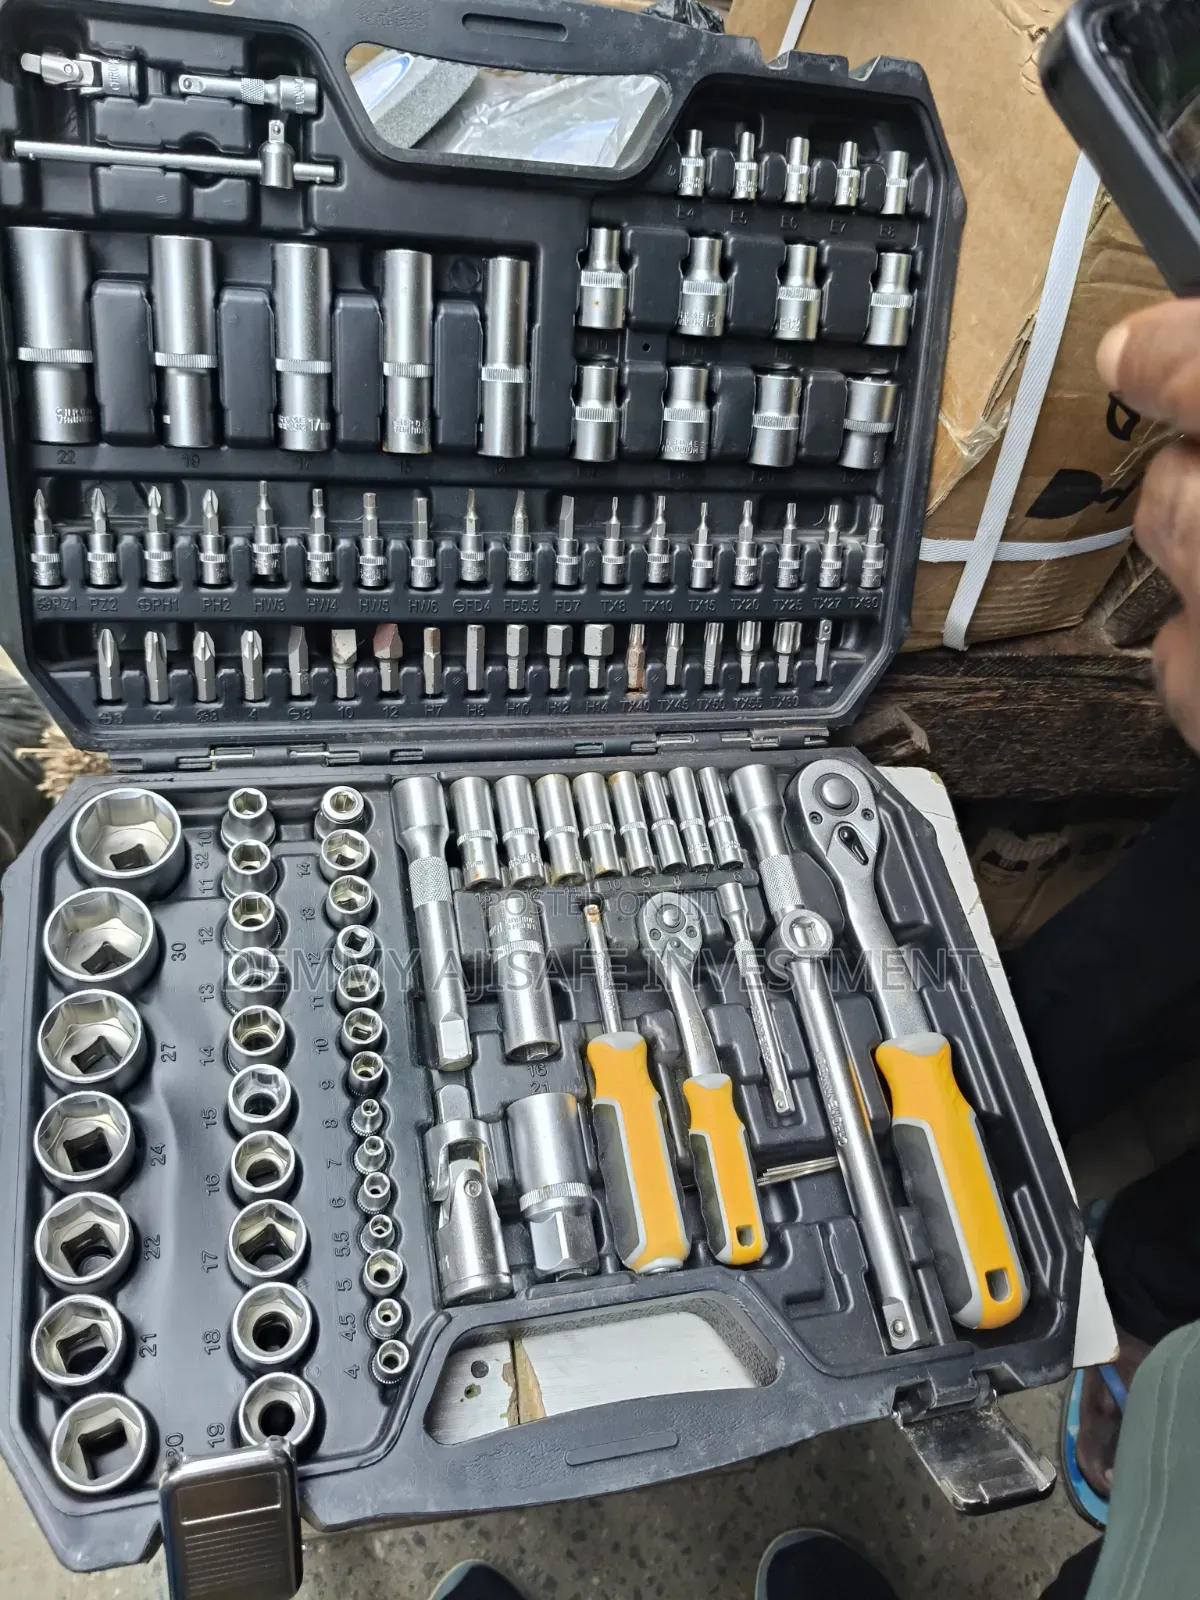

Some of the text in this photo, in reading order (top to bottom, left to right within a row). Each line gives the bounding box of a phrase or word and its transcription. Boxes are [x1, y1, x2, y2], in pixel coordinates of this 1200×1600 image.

[829, 217, 849, 234] E7
[56, 449, 77, 465] 22
[52, 597, 78, 612] PZ1
[89, 597, 119, 612] PZ2
[152, 597, 180, 612] PH1
[202, 597, 232, 612] PH2
[253, 597, 287, 613] HW3
[306, 598, 339, 613] HW4
[358, 598, 391, 613] HW5
[408, 599, 440, 614] HW6
[465, 599, 492, 613] FD4
[503, 599, 541, 613] FD5.5
[555, 599, 582, 613] FD7
[642, 599, 674, 613] TX10
[688, 599, 717, 613] TX15
[730, 598, 760, 612] TX20
[812, 597, 843, 610] TX27
[505, 702, 531, 716] H10
[547, 701, 572, 715] H12
[585, 700, 609, 714] H14
[619, 700, 651, 714] TX40
[657, 698, 690, 712] TX45
[732, 696, 764, 710] TX55
[337, 706, 355, 720] 10
[382, 705, 400, 719] 12
[424, 704, 445, 718] H7
[467, 704, 487, 718] H8
[199, 831, 213, 847] 10
[193, 851, 209, 870] 32
[296, 862, 311, 879] 14
[199, 879, 214, 894] 11
[606, 879, 623, 892] 10
[300, 906, 316, 923] 13
[198, 927, 213, 945] 12
[171, 941, 187, 962] 30
[198, 983, 214, 1003] 13
[310, 995, 325, 1010] 11
[160, 1041, 177, 1064] 27
[313, 1037, 329, 1057] 10
[199, 1046, 215, 1067] 14
[527, 1063, 549, 1078] 16
[529, 1080, 552, 1095] 21
[201, 1107, 217, 1129] 15
[150, 1143, 167, 1167] 24
[326, 1157, 342, 1170] 7
[205, 1173, 220, 1197] 16
[143, 1234, 160, 1260] 22
[333, 1230, 351, 1259] 5.5
[201, 1250, 219, 1273] 17
[336, 1277, 353, 1292] 5
[338, 1313, 357, 1342] 4.5
[139, 1333, 157, 1359] 21
[203, 1329, 222, 1355] 18
[343, 1364, 361, 1380] 4
[206, 1423, 226, 1449] 19
